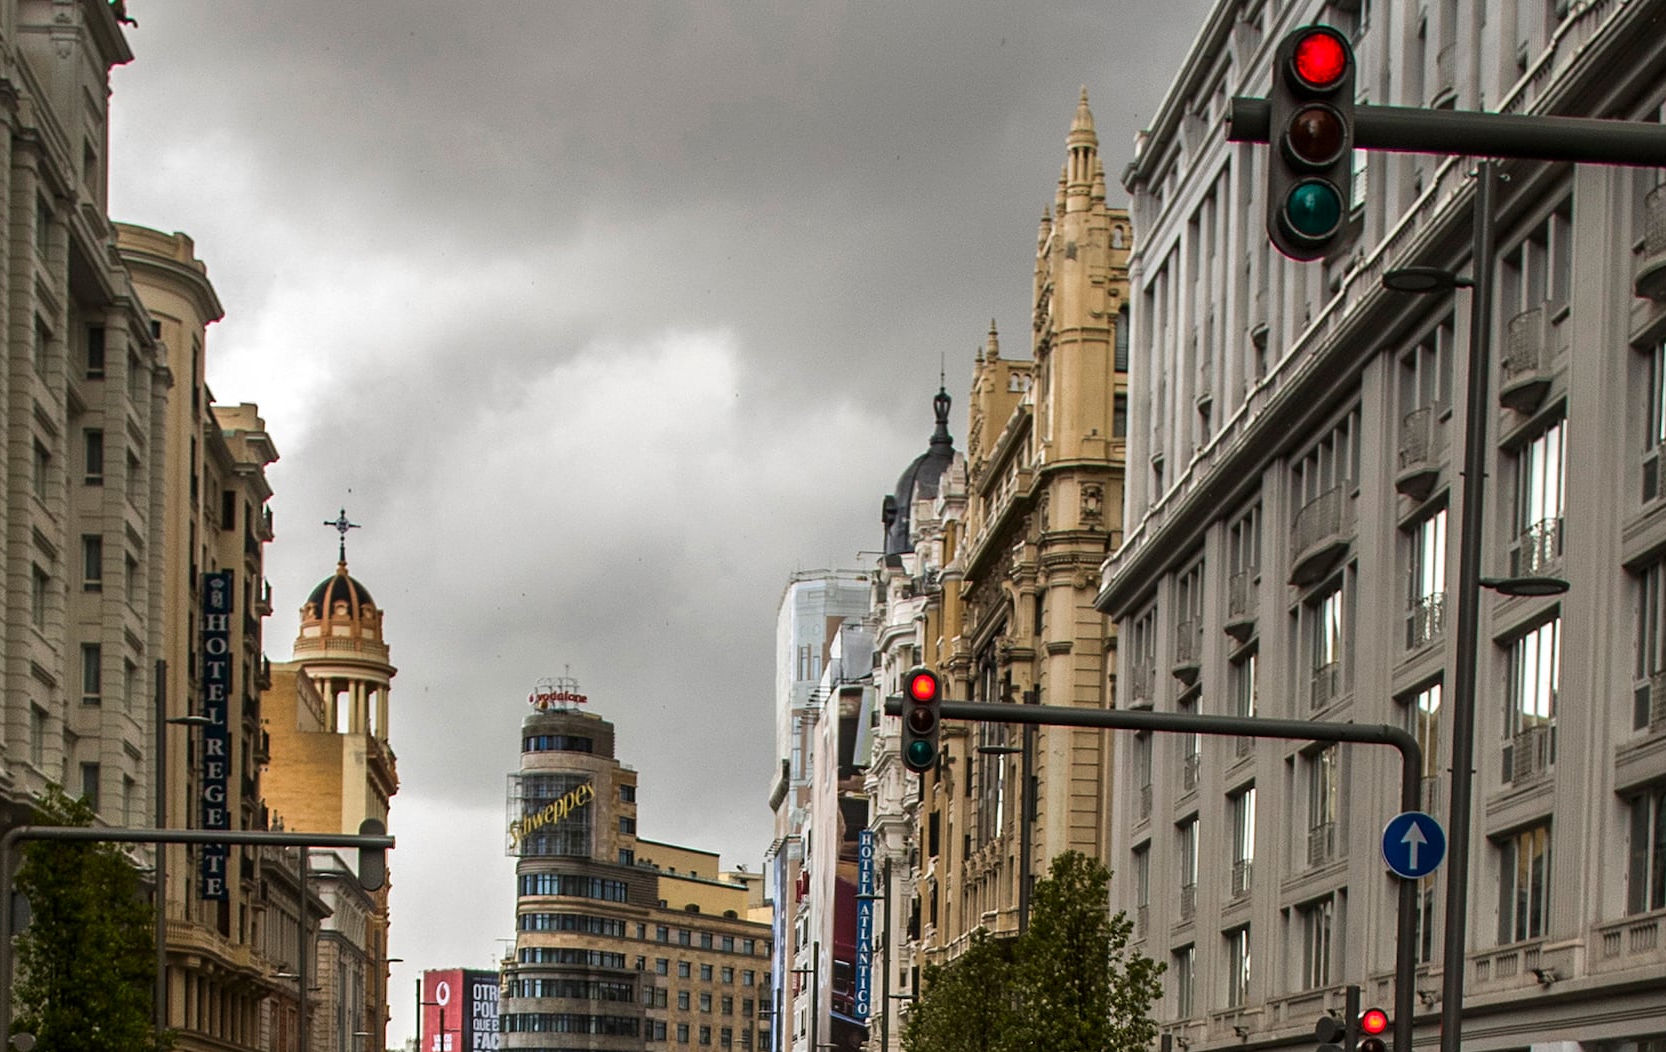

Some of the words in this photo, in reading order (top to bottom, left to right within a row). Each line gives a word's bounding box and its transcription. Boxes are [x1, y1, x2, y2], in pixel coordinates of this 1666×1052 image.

[205, 613, 228, 726] HOTEL
[536, 690, 588, 704] vodafone
[203, 736, 226, 897] REGETE
[509, 777, 597, 851] Schweppes
[860, 833, 873, 894] HOTEL
[473, 983, 500, 1001] OTR
[473, 1018, 491, 1032] QUE
